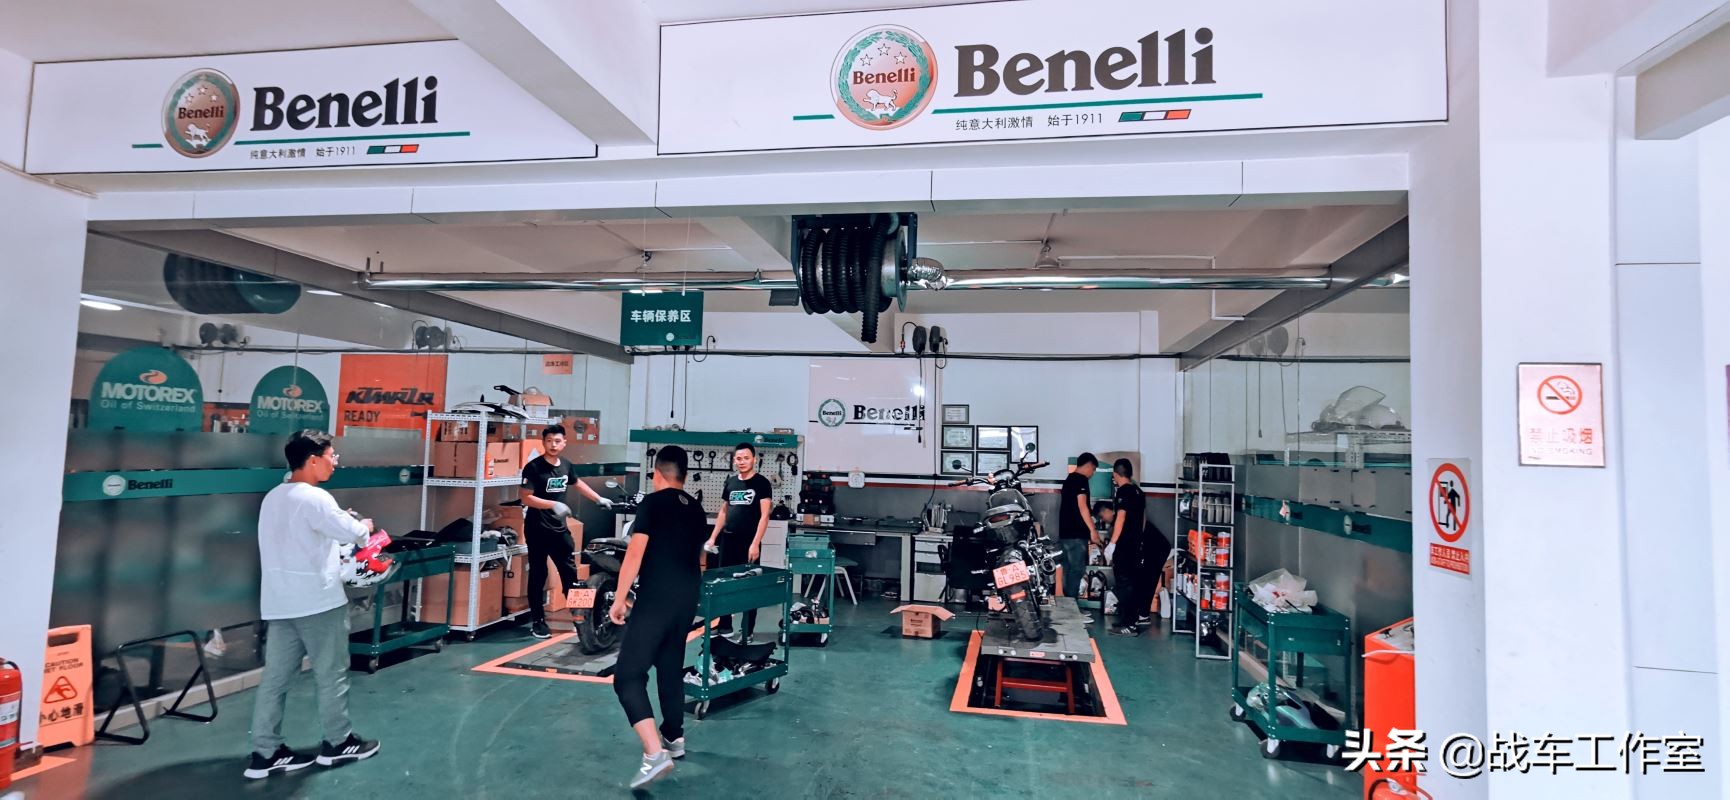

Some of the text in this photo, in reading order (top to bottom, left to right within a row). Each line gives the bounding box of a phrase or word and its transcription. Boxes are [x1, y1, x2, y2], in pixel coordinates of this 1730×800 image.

[953, 27, 1217, 98] Benelli
[853, 67, 916, 86] Benelli
[250, 75, 438, 131] Benelli
[178, 105, 225, 120] Benelli
[955, 113, 1104, 131] 纯意大利激情 始于1911
[630, 309, 691, 322] 车辆保养区
[101, 382, 195, 404] MOTOREX
[101, 400, 196, 413] Oil of Switzerland
[257, 396, 324, 413] MOTOREX
[344, 411, 380, 422] READY
[128, 478, 173, 490] Benelli
[45, 658, 79, 668] CAUTION
